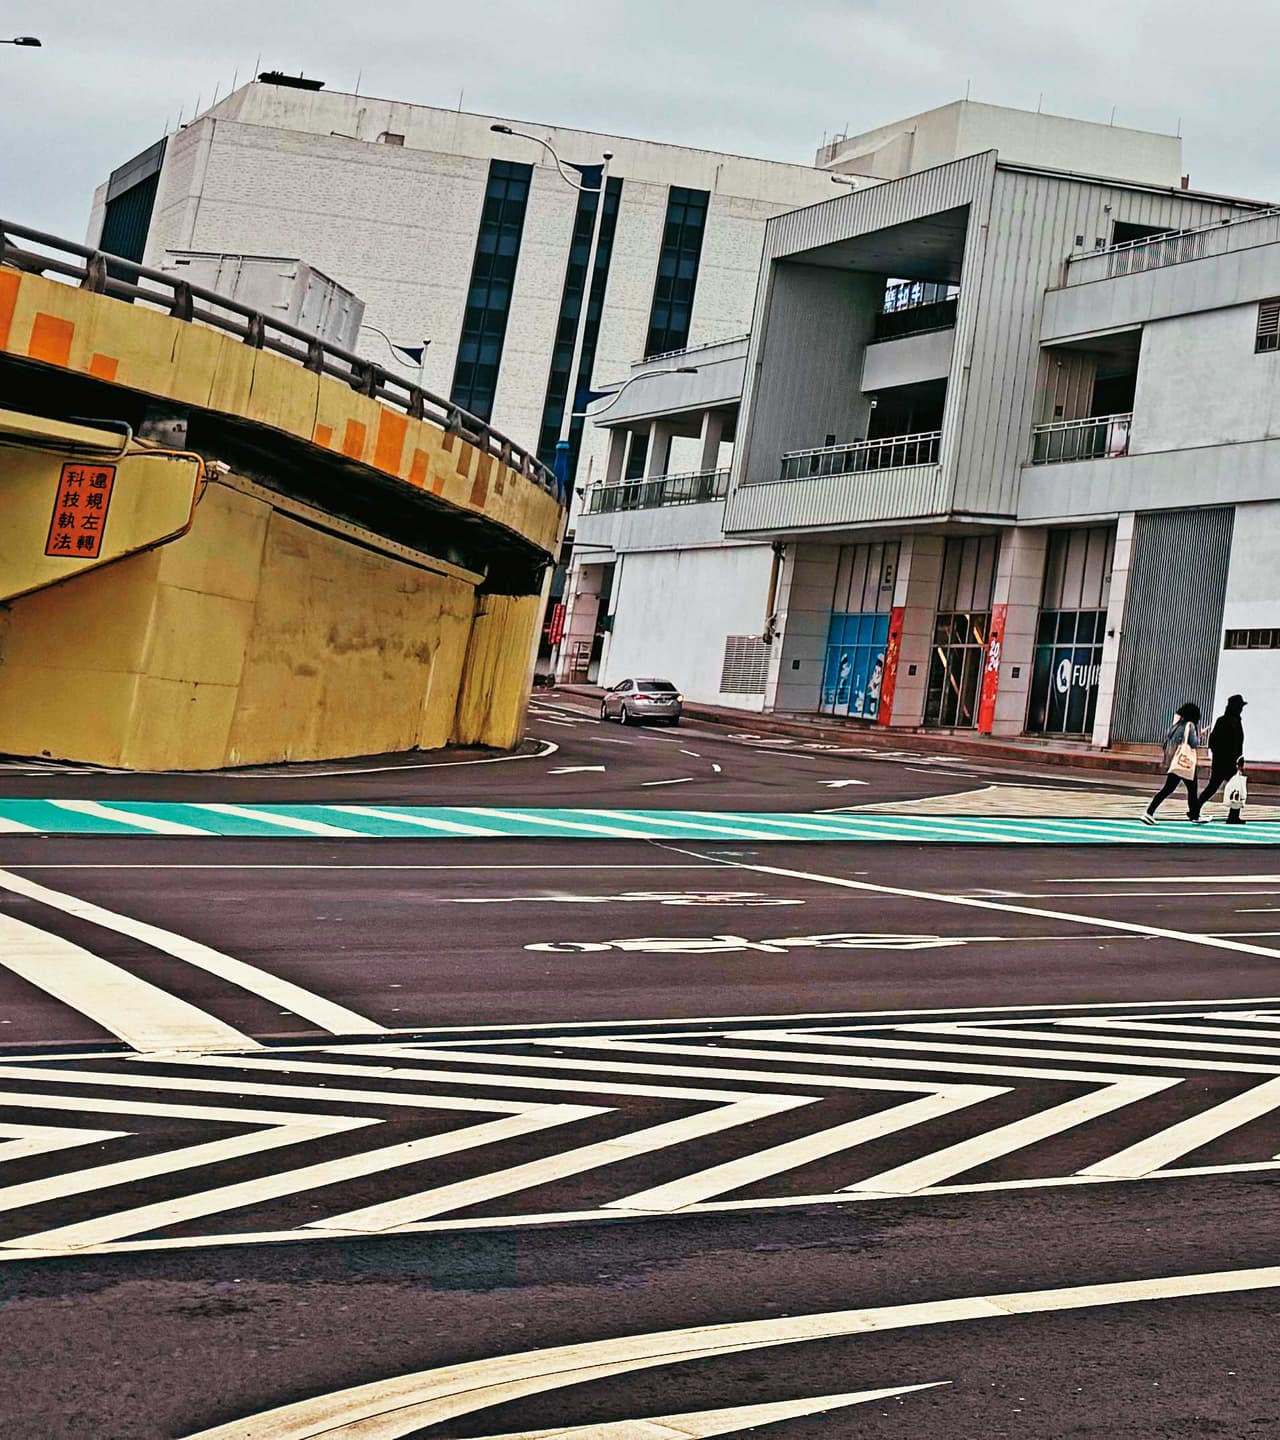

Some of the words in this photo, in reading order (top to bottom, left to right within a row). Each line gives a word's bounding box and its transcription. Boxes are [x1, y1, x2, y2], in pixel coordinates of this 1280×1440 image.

[53, 470, 85, 550] 科技執法
[76, 471, 108, 551] 違規左轉
